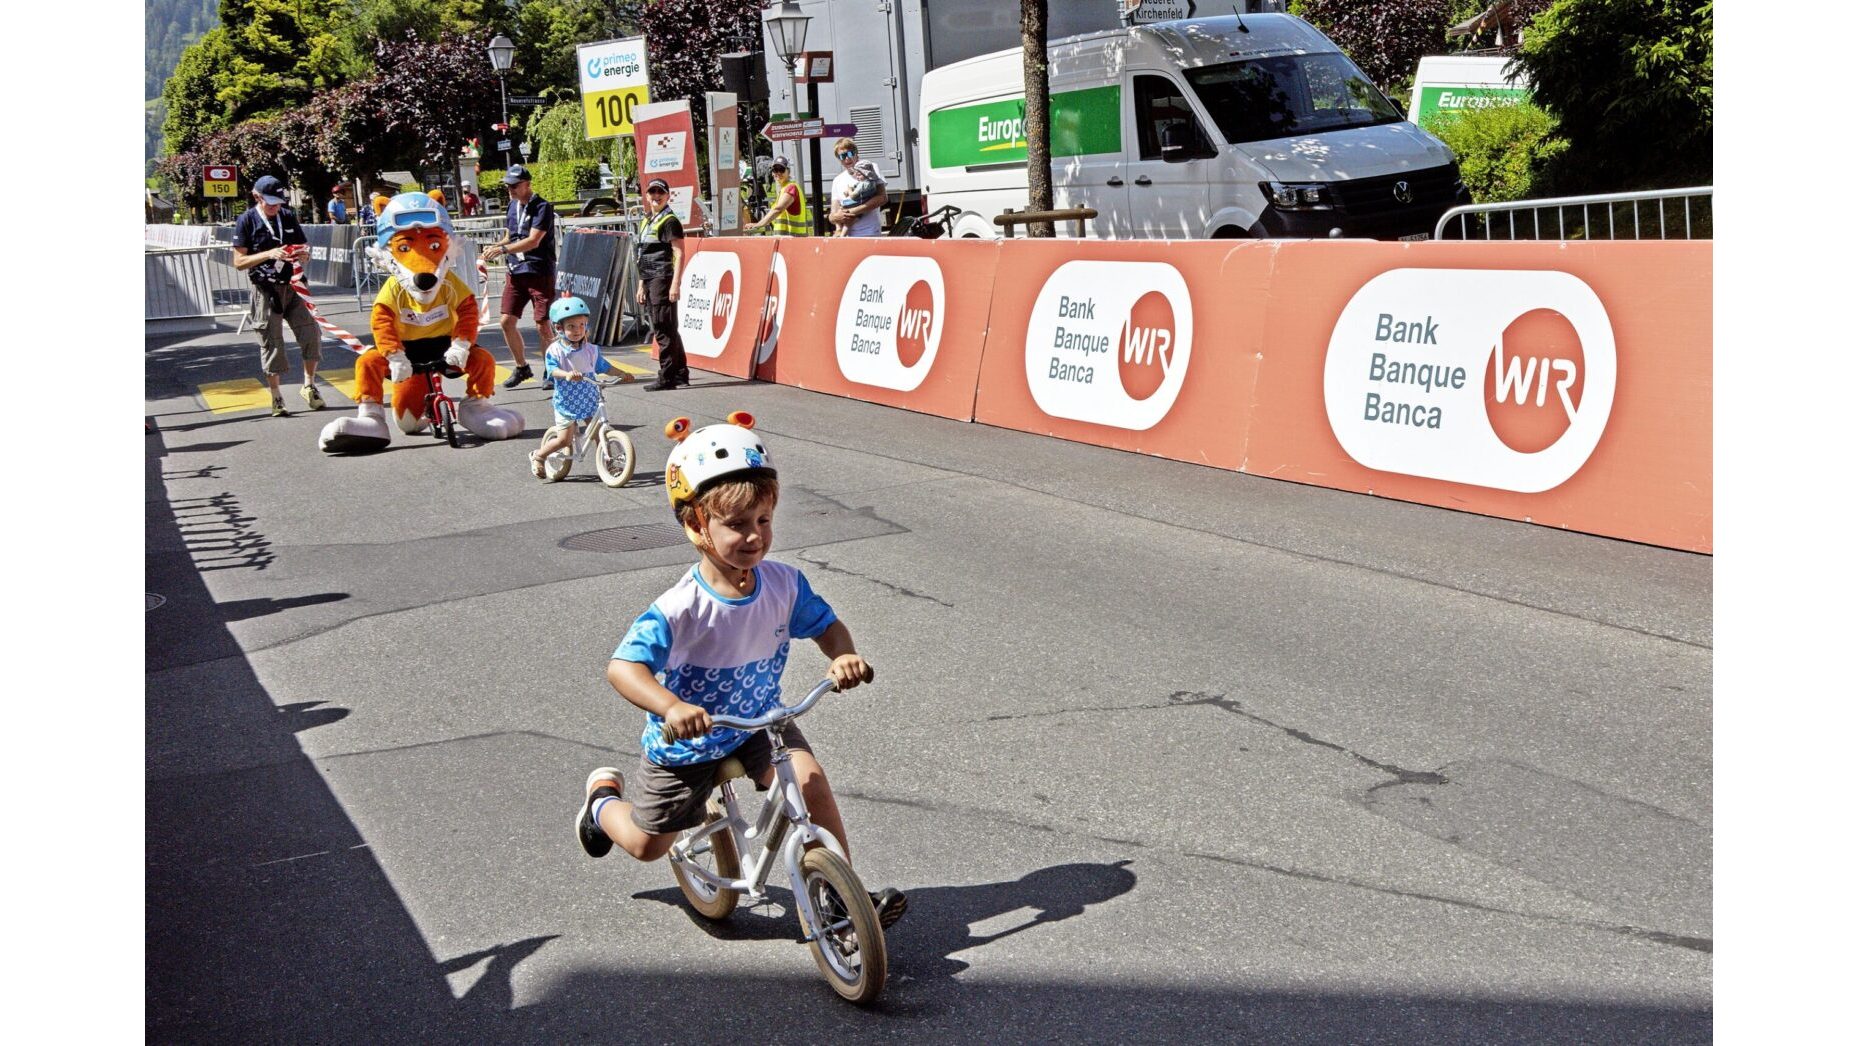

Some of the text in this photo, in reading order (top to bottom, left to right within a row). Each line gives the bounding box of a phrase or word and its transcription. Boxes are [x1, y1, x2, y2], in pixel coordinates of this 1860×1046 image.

[1136, 8, 1183, 19] Kirchenfeld
[603, 53, 637, 67] primeo
[604, 62, 640, 78] energie
[596, 92, 639, 128] 100
[212, 184, 230, 193] 150
[690, 274, 706, 289] Bank
[859, 284, 885, 303] Bank
[687, 294, 711, 313] Banque
[1058, 296, 1096, 320] Bank
[683, 313, 703, 330] Banca
[855, 309, 892, 334] Banque
[900, 305, 931, 345] WIR
[1375, 313, 1439, 345] Bank
[850, 334, 882, 355] Banca
[1053, 326, 1109, 357] Banque
[1124, 322, 1171, 372] WIR
[1048, 357, 1094, 384] Banca
[1368, 352, 1466, 393] Banque
[1494, 342, 1577, 417] WIR
[1364, 392, 1442, 429] Banca
